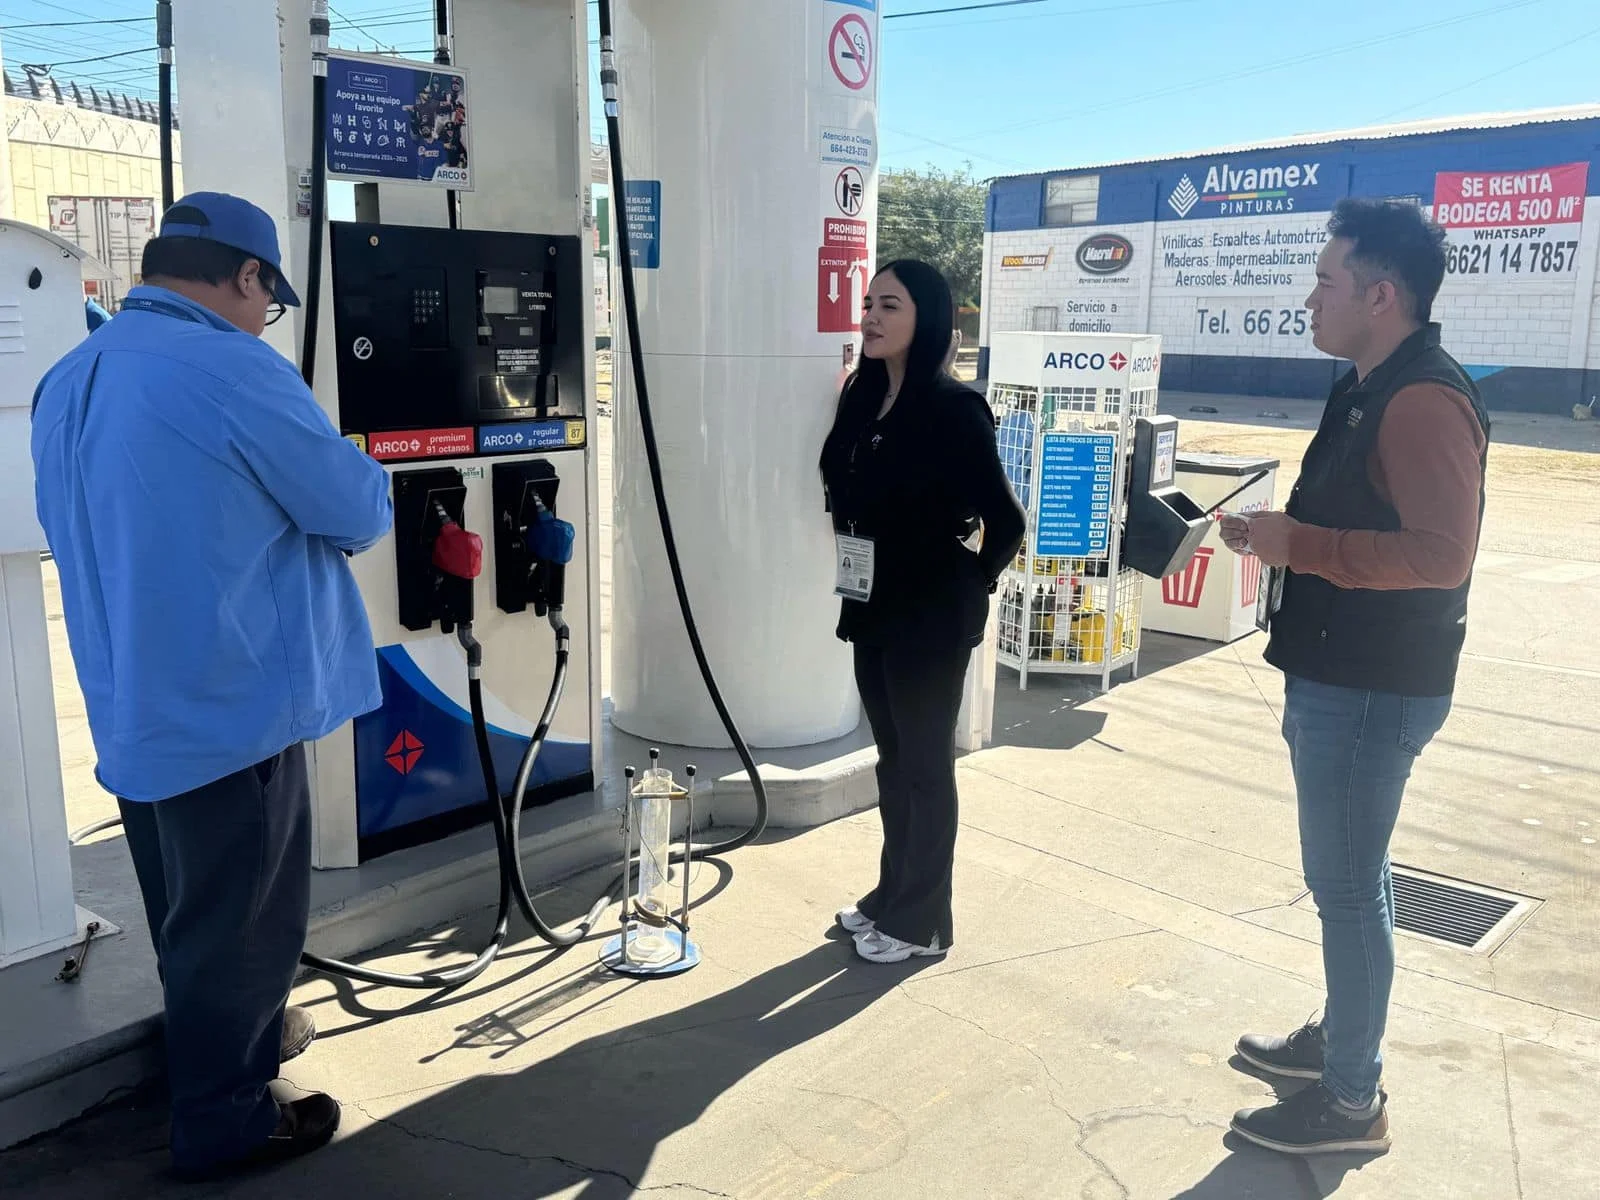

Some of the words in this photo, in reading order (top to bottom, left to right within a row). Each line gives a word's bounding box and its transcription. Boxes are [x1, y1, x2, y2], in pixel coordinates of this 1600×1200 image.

[336, 90, 360, 103] Apoya
[366, 93, 375, 102] tu
[376, 95, 400, 106] equipo
[354, 103, 384, 114] favorito
[437, 170, 460, 180] ARCO
[1203, 163, 1320, 193] Alvamex
[1461, 177, 1483, 197] SE
[1489, 172, 1552, 196] RENTA
[1220, 198, 1294, 215] PINTURAS
[1437, 201, 1511, 224] BODEGA
[1517, 198, 1552, 221] 500
[828, 223, 865, 235] PROHIBIDO
[1473, 227, 1546, 240] WHATSAPP
[1213, 231, 1261, 247] Esmaltes
[1264, 228, 1327, 246] Automotriz
[1164, 251, 1209, 268] Maderas
[1216, 249, 1318, 269] Impermeabilizant
[1447, 243, 1491, 274] 6621
[1500, 243, 1522, 273] 14
[1529, 240, 1578, 272] 7857
[1175, 270, 1227, 286] Aerosoles
[1233, 269, 1292, 285] Adhesivos
[1066, 299, 1106, 313] Servicio
[1110, 303, 1118, 312] a
[1069, 318, 1112, 333] domicilio
[1197, 309, 1230, 334] Tel.
[1243, 309, 1272, 335] 66
[1278, 309, 1307, 335] 25
[1044, 352, 1105, 370] ARCO
[1132, 356, 1152, 373] ARCO
[429, 433, 466, 445] premium
[532, 427, 559, 438] regular
[571, 428, 581, 439] 87
[374, 440, 408, 454] ARCO
[483, 434, 513, 447] ARCO
[527, 438, 537, 446] 87
[537, 437, 565, 446] octanos
[426, 445, 437, 453] 91
[438, 444, 470, 453] octanos
